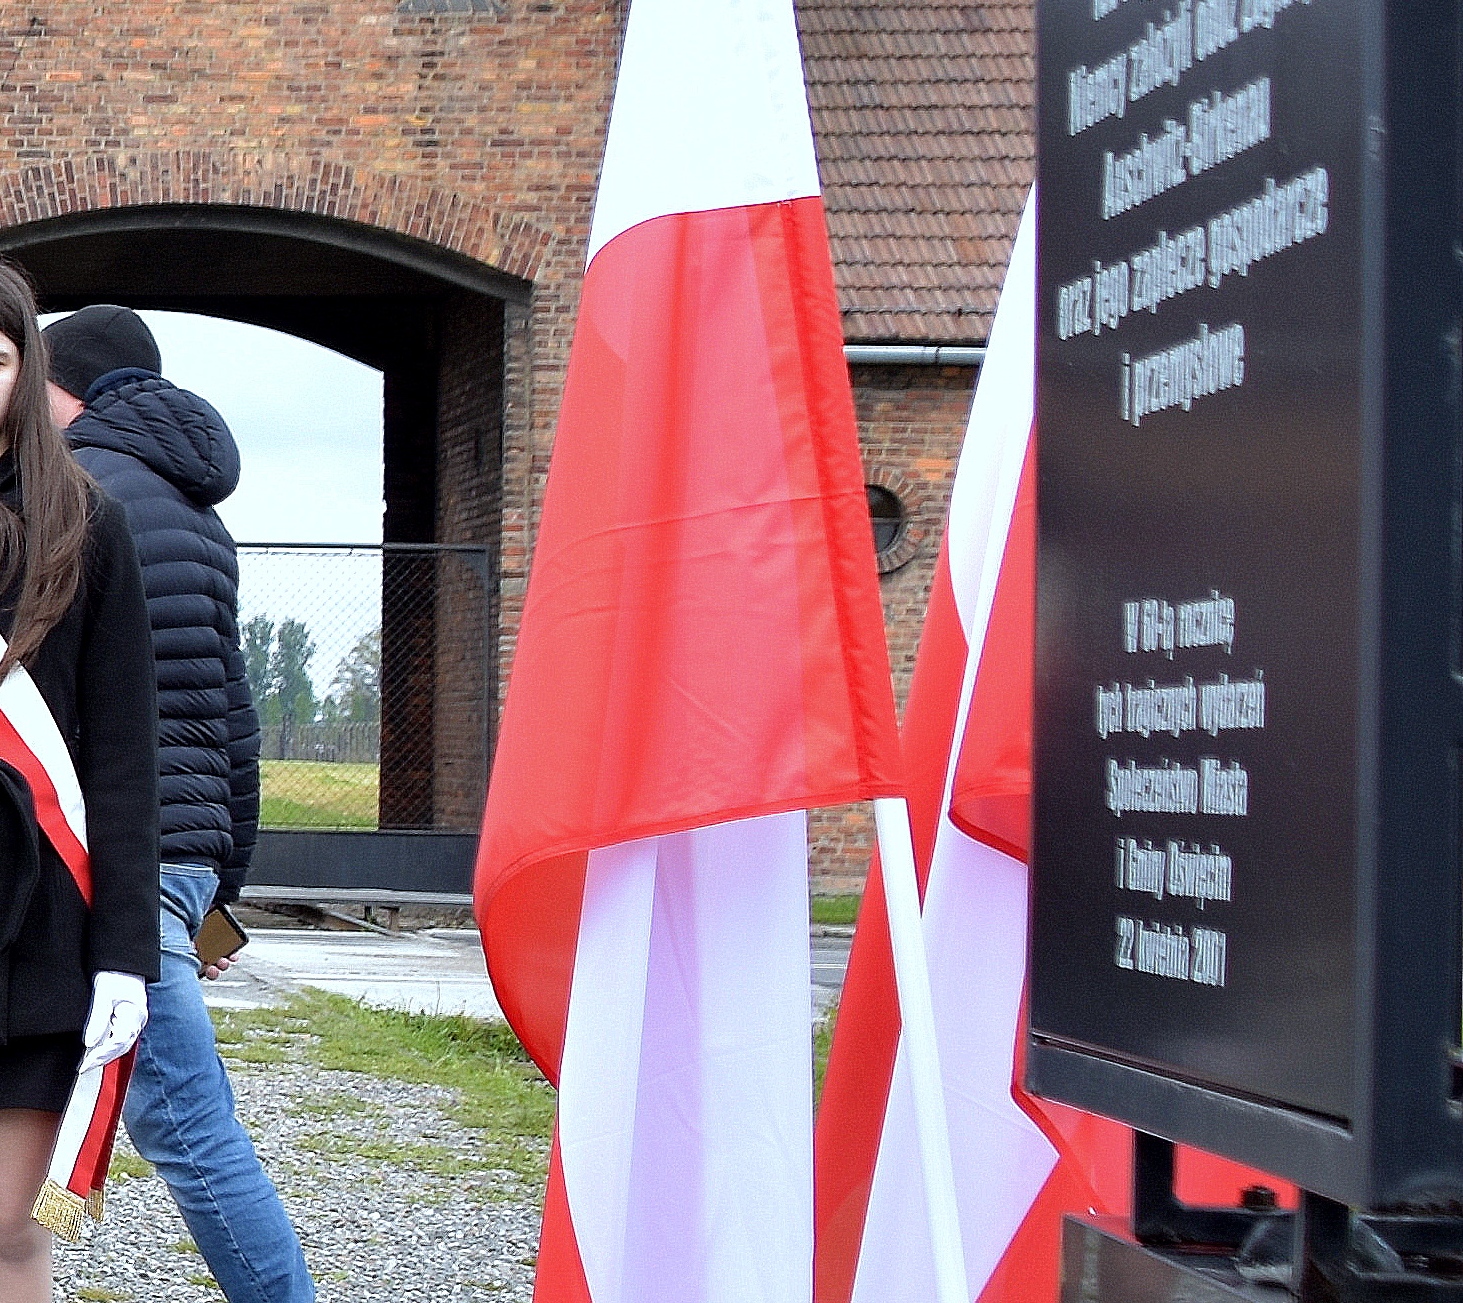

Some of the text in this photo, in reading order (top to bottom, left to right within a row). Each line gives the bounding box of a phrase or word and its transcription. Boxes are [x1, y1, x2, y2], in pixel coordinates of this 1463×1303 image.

[1069, 54, 1126, 136] Niemcy
[1101, 77, 1271, 220] Auschwitz-Birkenau
[1059, 167, 1329, 340] oraz jego zaplecze gospodarcze
[1122, 324, 1245, 426] i przemysłowe
[1124, 602, 1139, 653] W
[1177, 589, 1235, 654] rocznicę
[1097, 670, 1265, 739] tych tragicznych wydarzeń
[1107, 759, 1248, 817] Społeczeństwo Miasta
[1117, 838, 1231, 910] i Gminy Oświęcim
[1116, 918, 1226, 987] 22 kwietnia 2001
